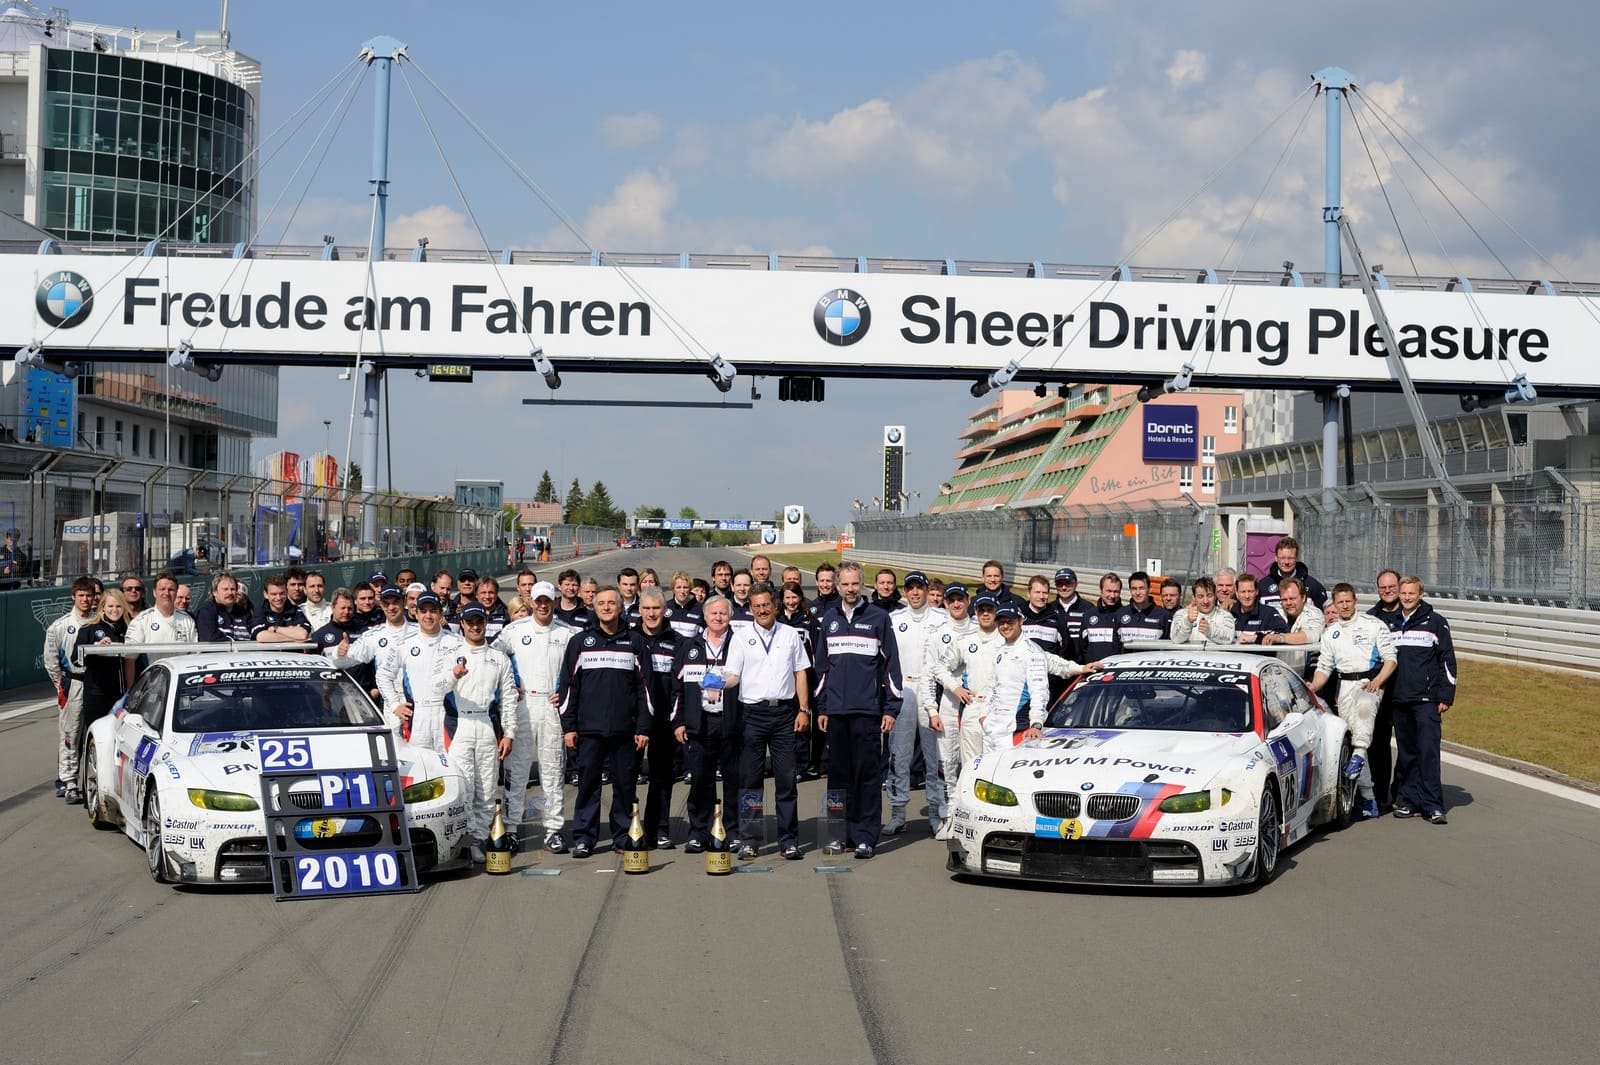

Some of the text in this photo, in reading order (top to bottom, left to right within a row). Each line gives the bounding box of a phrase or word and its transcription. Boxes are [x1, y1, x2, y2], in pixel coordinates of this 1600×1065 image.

[124, 277, 651, 336] Freude am Fahren
[901, 294, 1549, 367] Sheer Driving Pleasure
[1147, 422, 1194, 434] Dorint
[1172, 436, 1194, 444] Resorts
[1090, 466, 1178, 494] Bitte ein Bit
[1151, 560, 1157, 572] 1
[229, 659, 331, 669] randstad
[1138, 658, 1242, 670] randstad
[220, 670, 311, 679] GRAN TURISMO
[1119, 670, 1210, 680] GRAN TURISMO
[260, 739, 310, 769] 25
[1009, 756, 1196, 775] BMW M Power
[321, 773, 371, 807] P1
[415, 811, 445, 821] DUNLOP
[978, 814, 1010, 825] DUNLOP
[172, 819, 198, 831] Castrol
[213, 823, 255, 831] DUNLOP
[1227, 820, 1254, 832] Castrol
[164, 834, 185, 845] BBS
[1234, 835, 1257, 847] BBS
[298, 852, 399, 891] 2010
